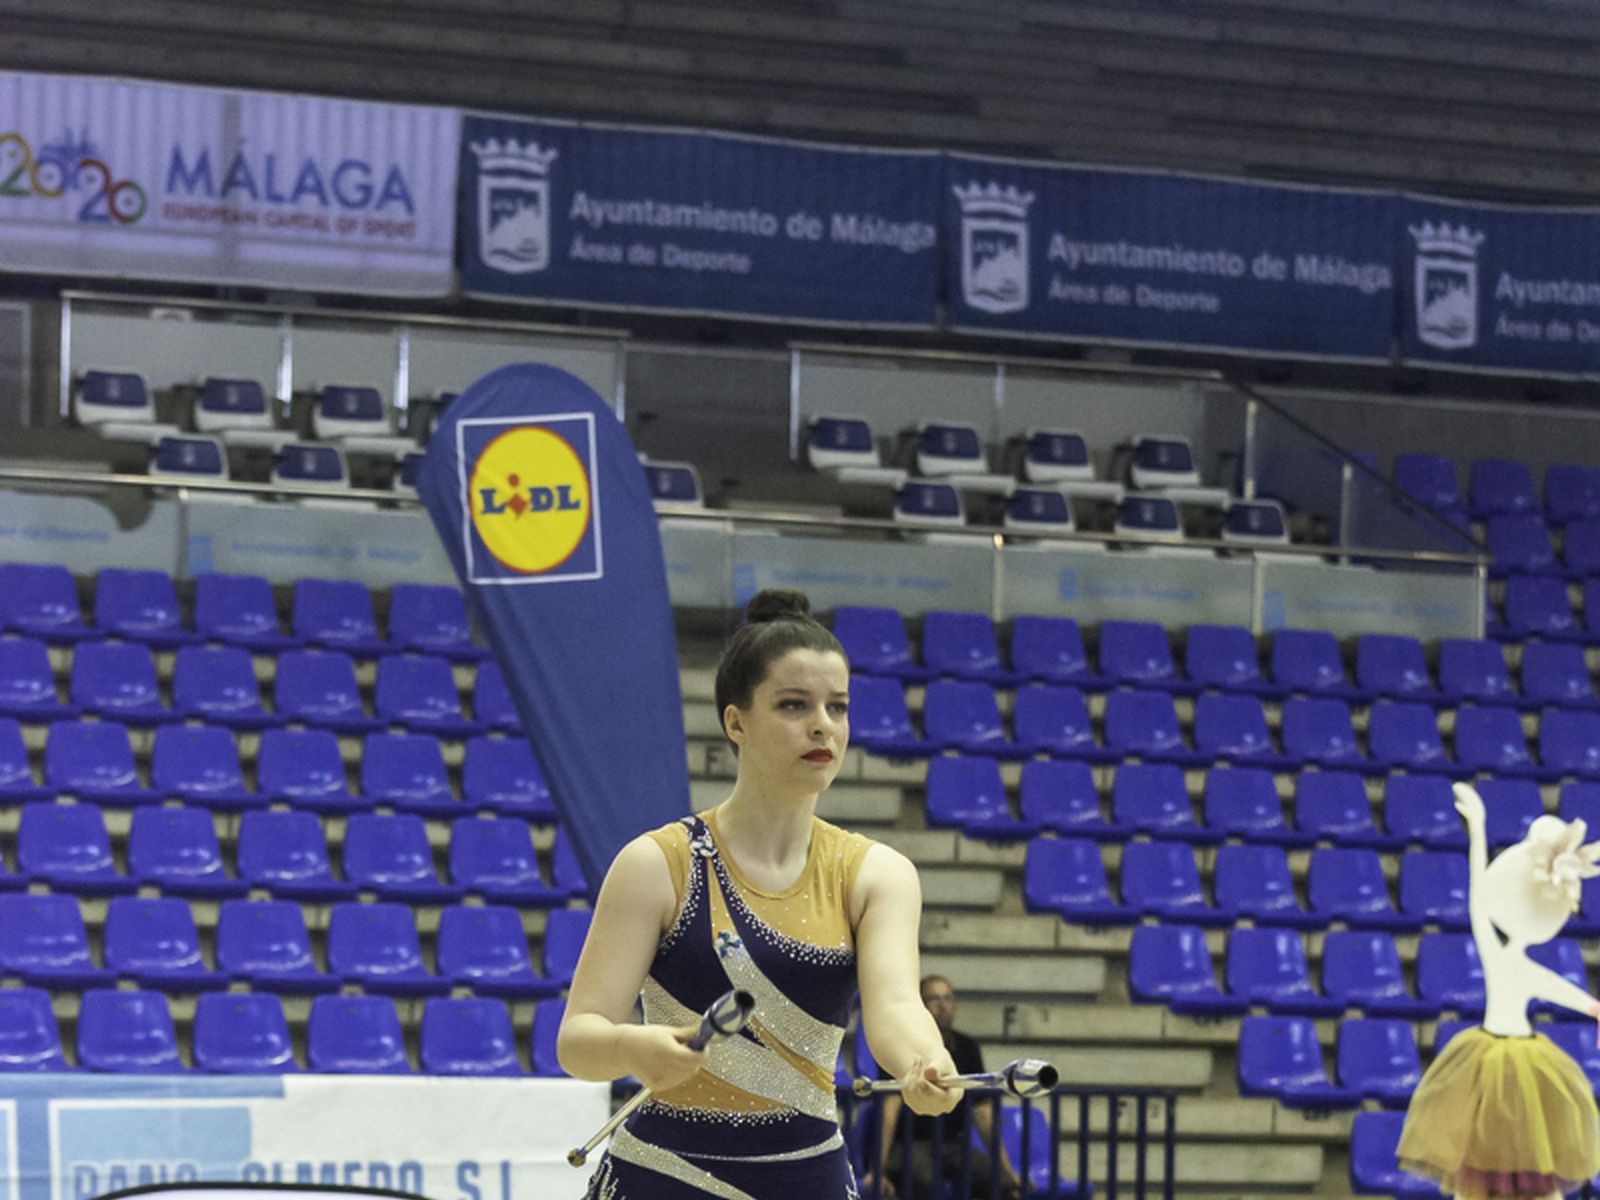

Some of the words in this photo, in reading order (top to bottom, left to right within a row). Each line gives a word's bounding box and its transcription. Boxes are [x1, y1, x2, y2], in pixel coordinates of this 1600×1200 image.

[165, 138, 416, 213] MÁLAGA
[569, 190, 778, 238] Ayuntamiento
[785, 211, 823, 241] de
[831, 212, 937, 253] Málaga
[569, 232, 624, 264] Área
[626, 241, 656, 267] de
[661, 243, 751, 274] Deporte
[1048, 232, 1246, 277] Ayuntamiento
[1252, 253, 1287, 281] de
[1294, 253, 1393, 294] Málaga
[1102, 284, 1131, 306] de
[1135, 284, 1220, 314] Deporte
[1544, 320, 1574, 342] de
